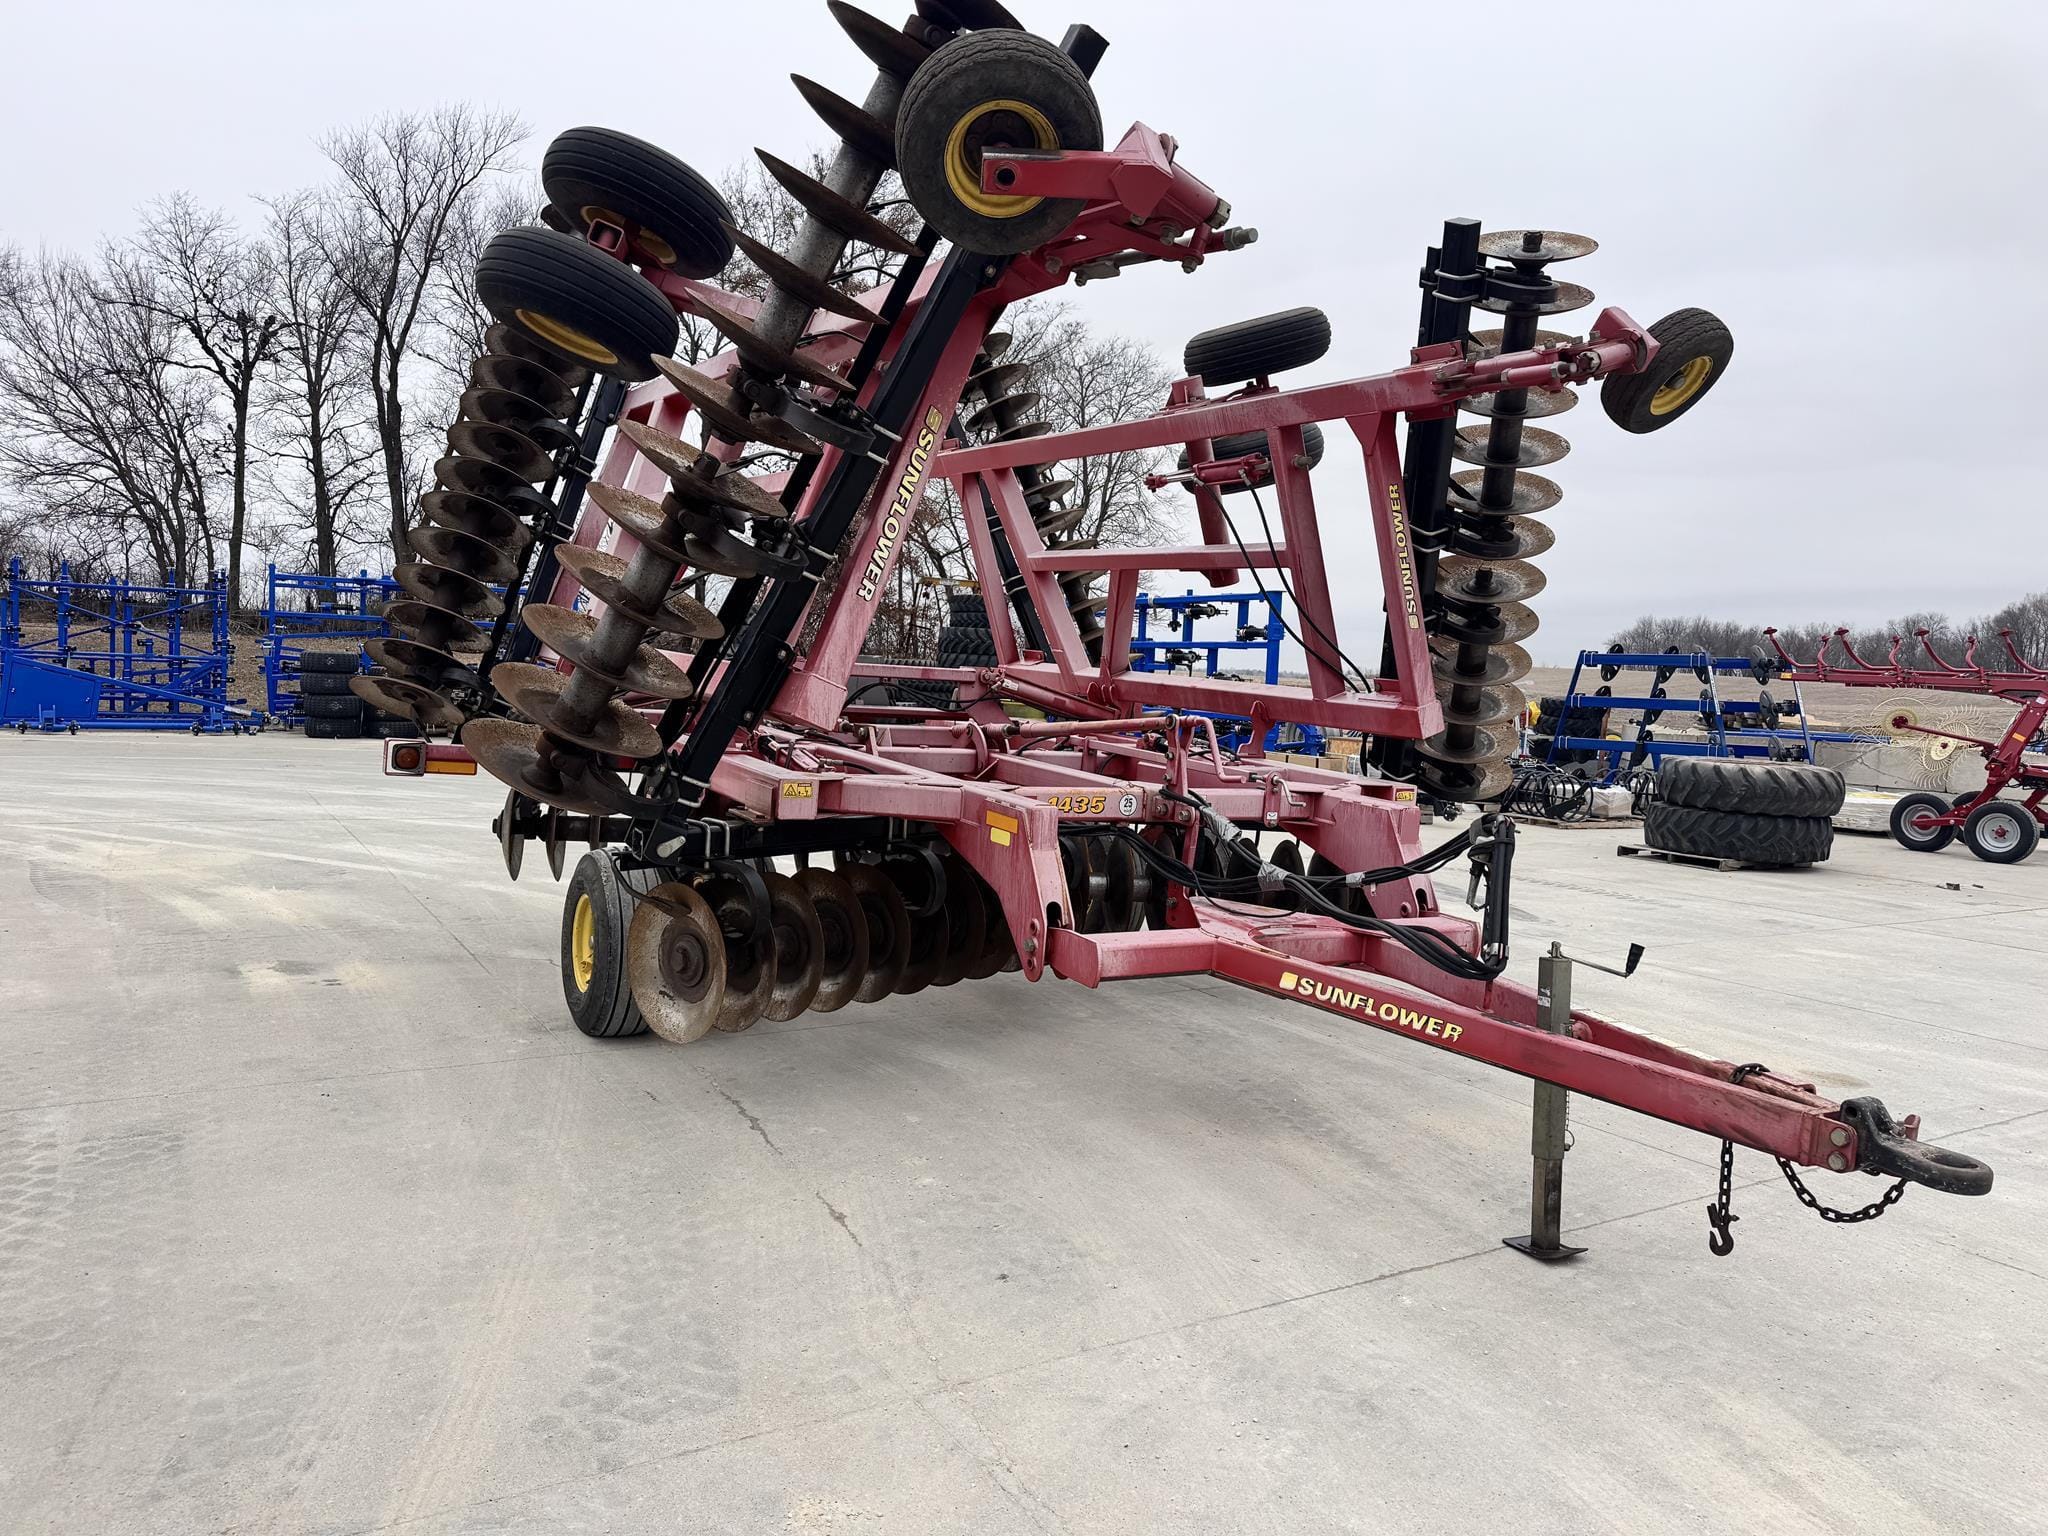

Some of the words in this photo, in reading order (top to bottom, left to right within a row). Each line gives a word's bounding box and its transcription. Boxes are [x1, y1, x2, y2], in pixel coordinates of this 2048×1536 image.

[857, 427, 934, 602] SUNFLOWER
[1389, 483, 1417, 613] SUNFLOWER
[1048, 796, 1106, 814] 1435
[1124, 798, 1133, 807] 25
[1298, 977, 1464, 1042] SUNFLOWER
